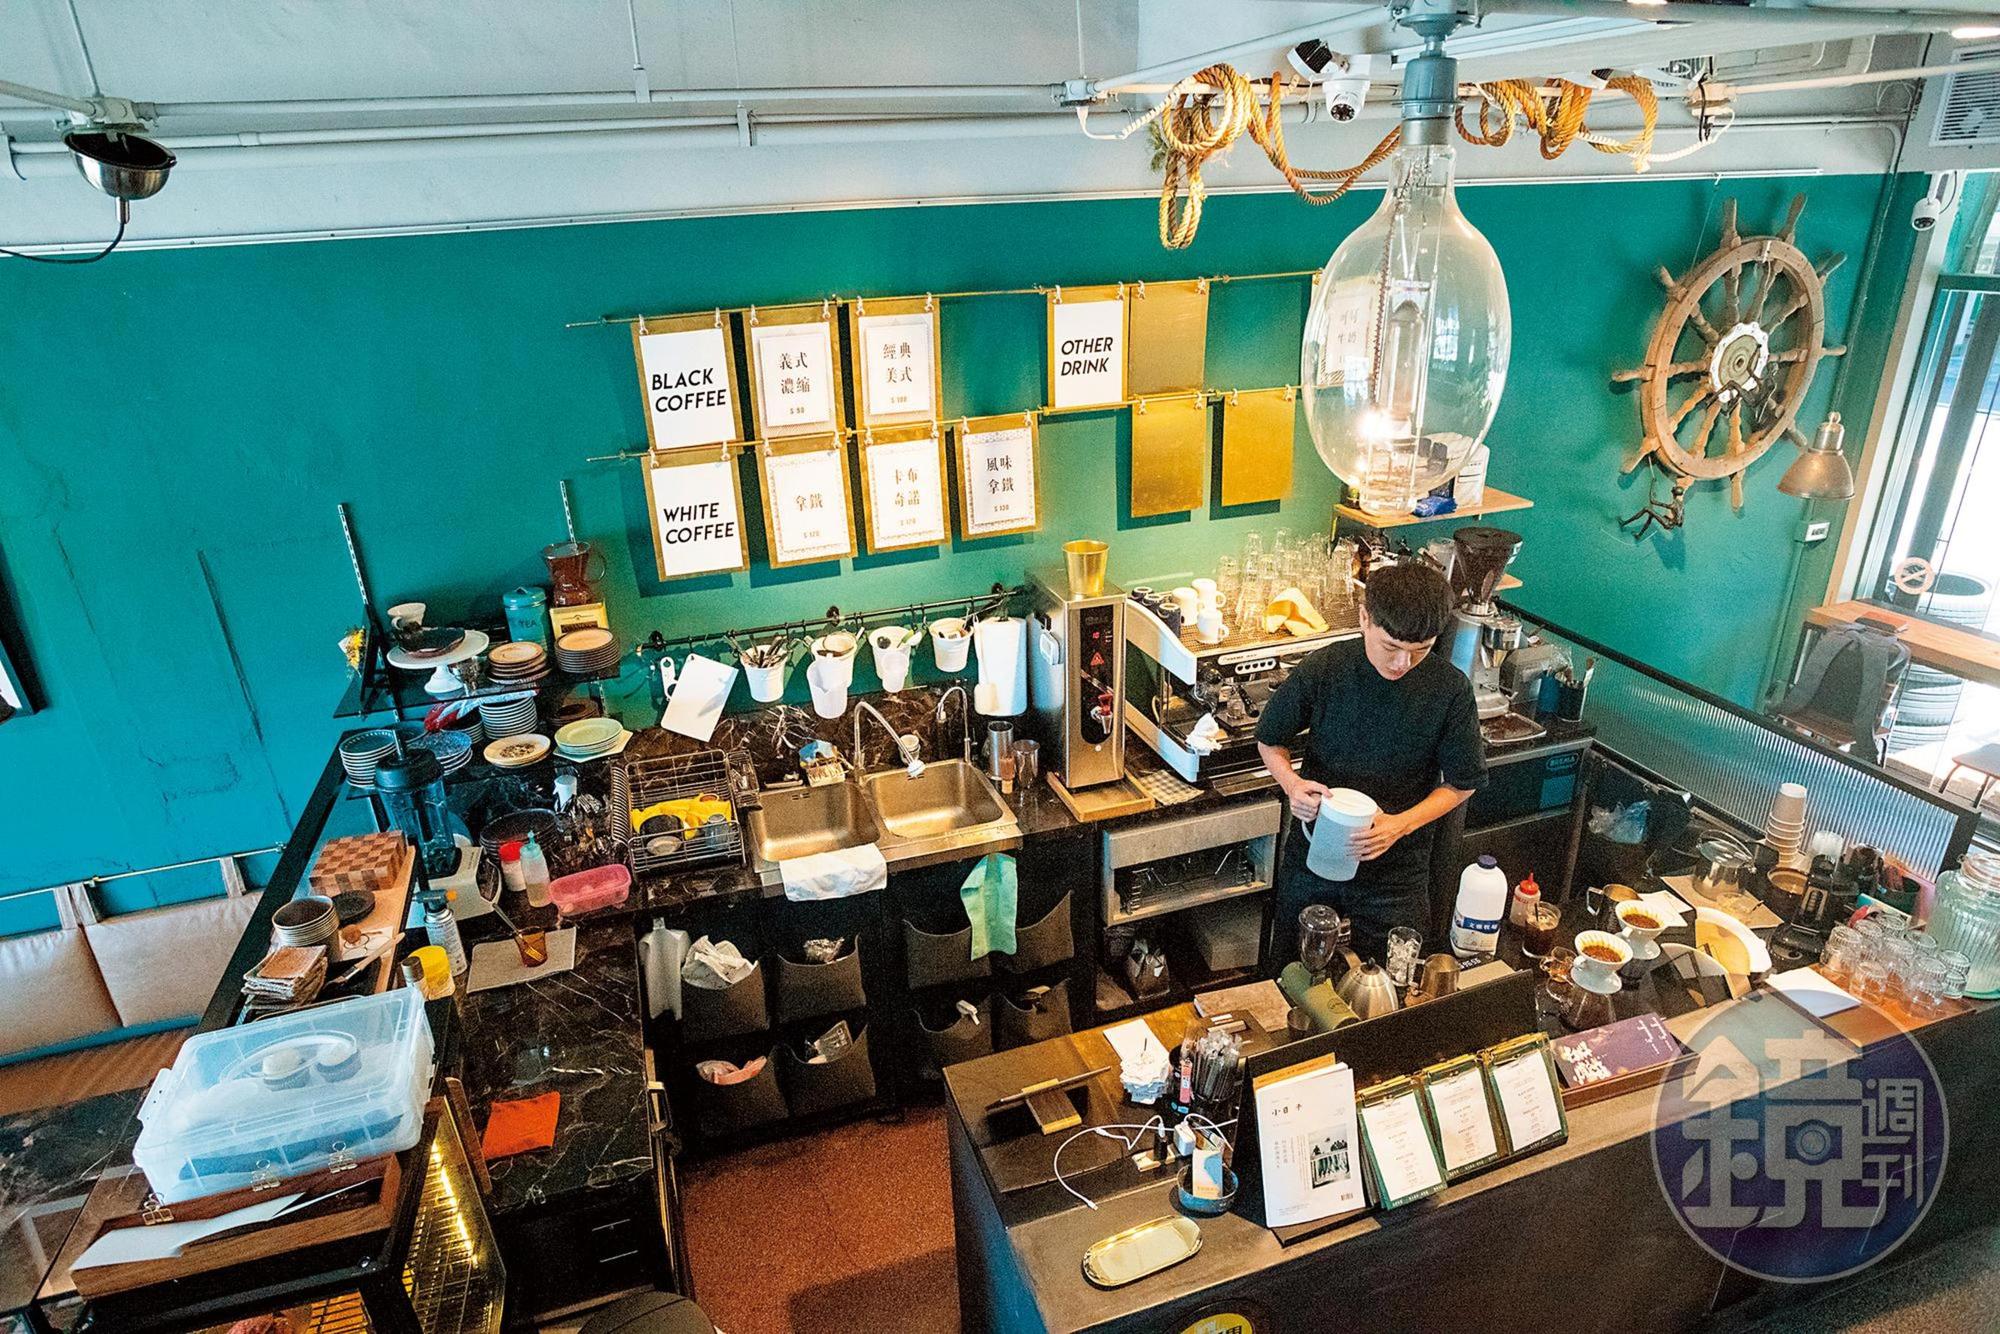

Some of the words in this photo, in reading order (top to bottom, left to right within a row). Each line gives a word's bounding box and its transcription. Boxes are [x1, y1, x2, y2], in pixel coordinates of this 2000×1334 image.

[1061, 336, 1113, 355] OTHER
[779, 352, 808, 370] 義式
[1061, 357, 1109, 376] DRINK
[652, 368, 713, 390] BLACK
[886, 366, 912, 383] 美式
[656, 389, 726, 412] COFFEE
[986, 454, 1012, 472] 風味
[988, 477, 1014, 495] 拿鐵
[663, 502, 719, 522] WHITE
[666, 522, 735, 544] COFFEE
